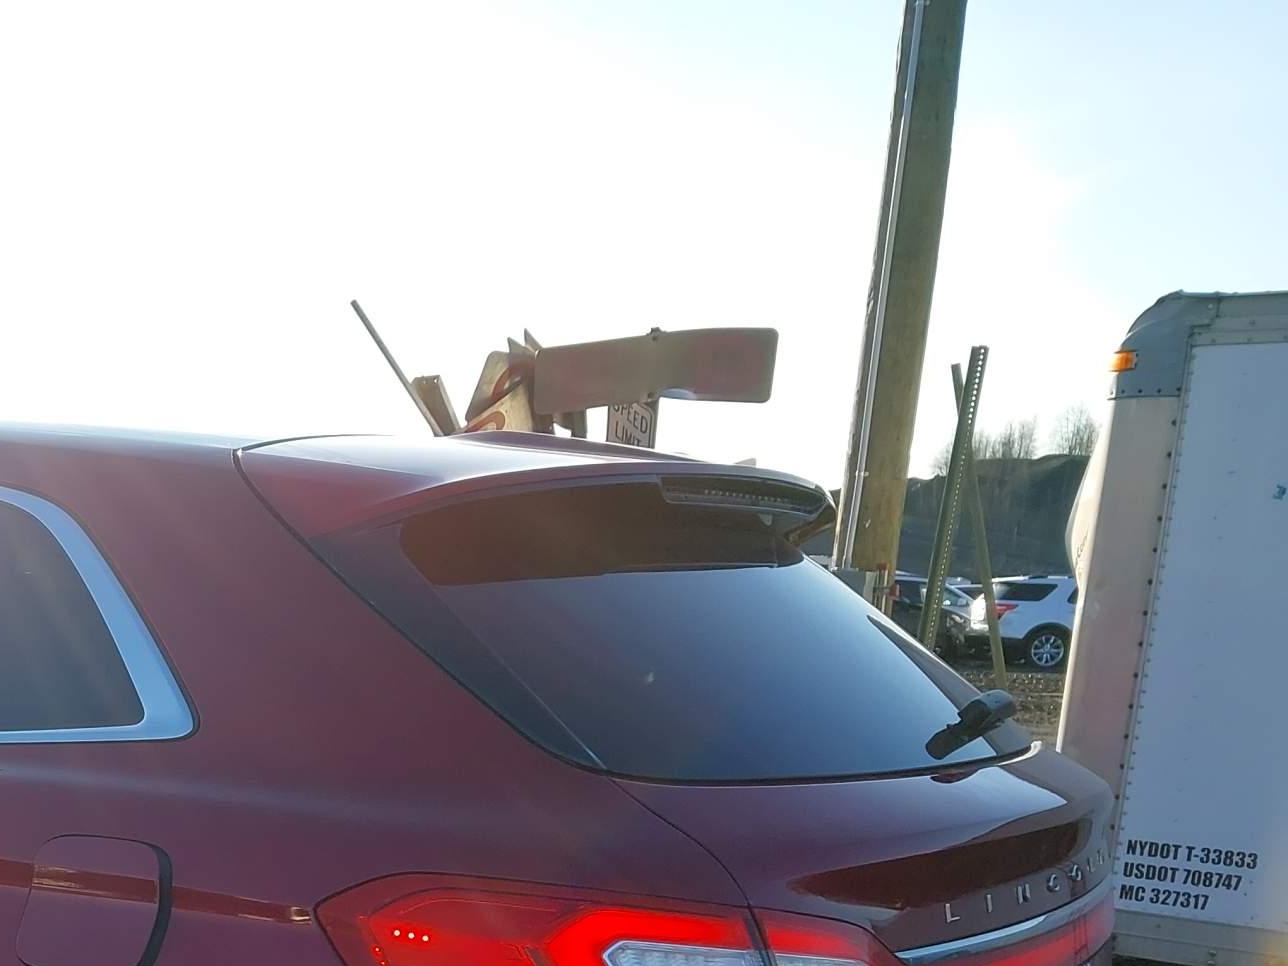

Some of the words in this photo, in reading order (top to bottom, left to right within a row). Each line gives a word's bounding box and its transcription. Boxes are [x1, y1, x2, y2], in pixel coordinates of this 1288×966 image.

[1126, 839, 1182, 860] NYDOT
[1186, 846, 1258, 870] T-33833
[1123, 862, 1180, 884] USDOT
[1182, 869, 1243, 891] 708747
[1119, 884, 1146, 901] MC
[1149, 888, 1210, 910] 327317
